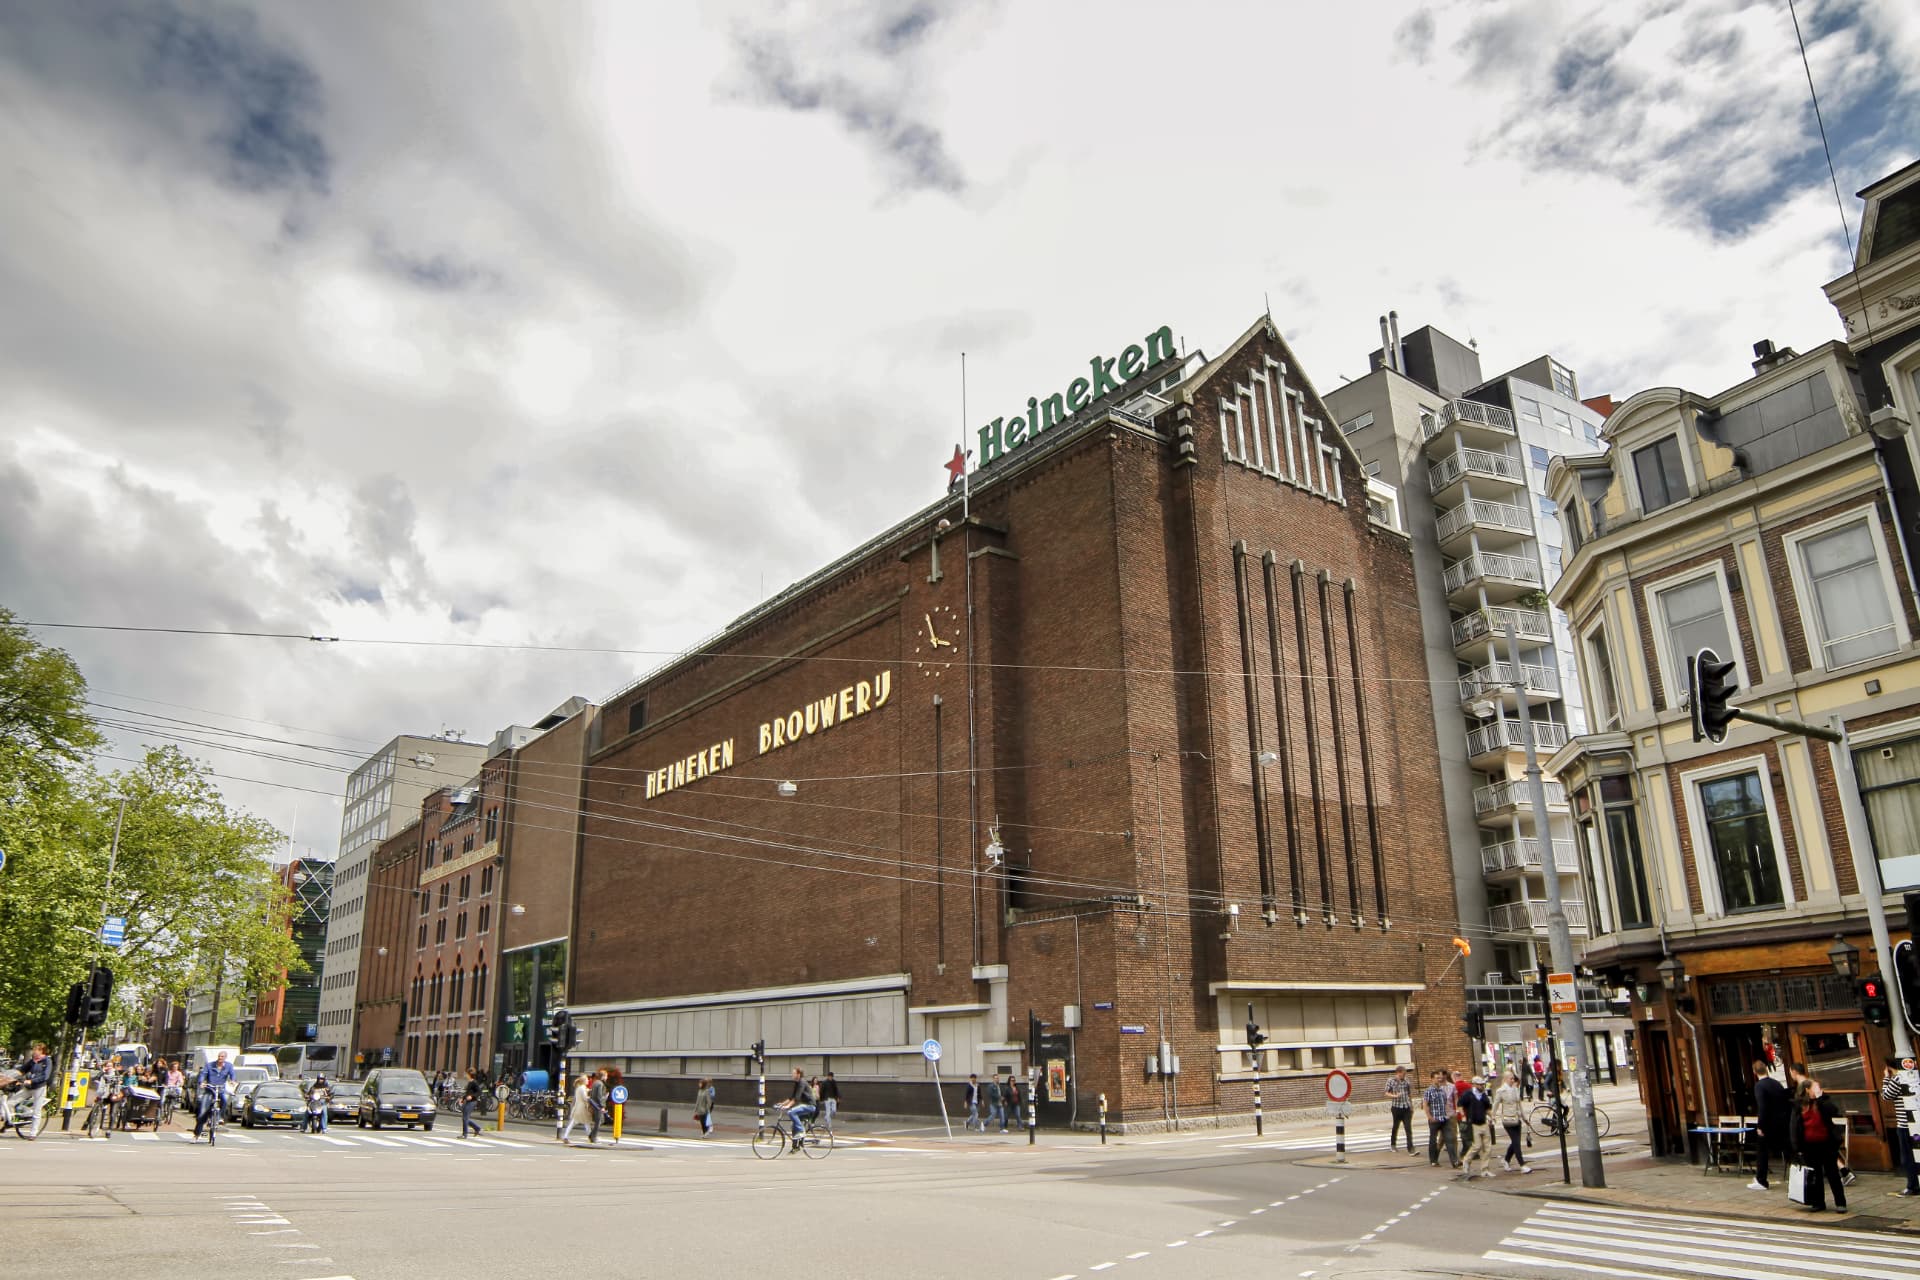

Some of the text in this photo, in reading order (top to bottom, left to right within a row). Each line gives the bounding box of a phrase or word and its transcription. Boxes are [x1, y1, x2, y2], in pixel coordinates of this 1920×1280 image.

[978, 325, 1176, 468] Heineken
[646, 670, 891, 800] HEINEKEN BROUWERIJ
